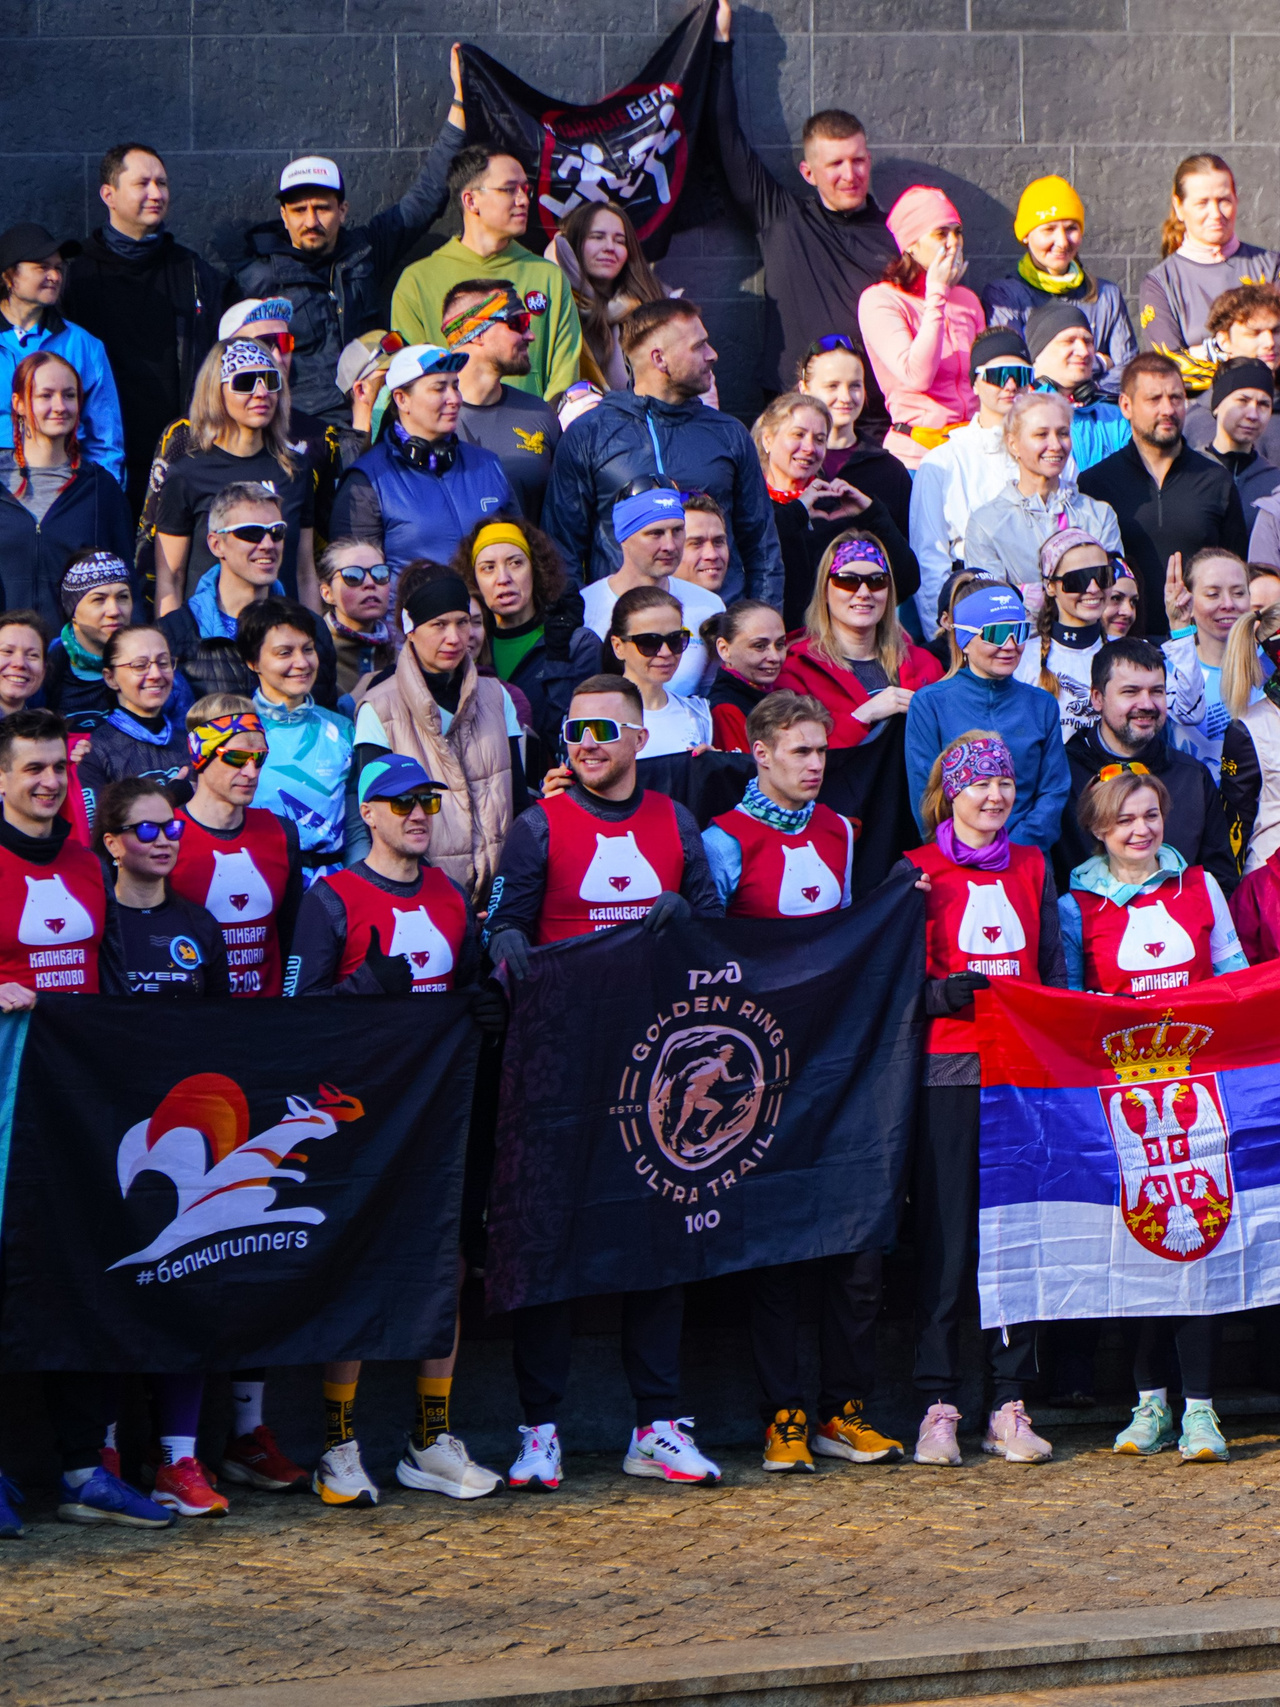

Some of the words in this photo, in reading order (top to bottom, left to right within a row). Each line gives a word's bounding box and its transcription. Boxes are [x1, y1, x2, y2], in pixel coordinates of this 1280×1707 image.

[626, 83, 675, 120] БЕГА
[222, 926, 267, 945] АПИБАРА
[29, 948, 85, 969] КАПИБАРА
[226, 948, 264, 966] УСКОВО
[967, 959, 1020, 977] КАПИБАРА
[36, 969, 85, 989] КУСКОВО
[229, 970, 262, 993] 5:00
[1131, 970, 1189, 993] КАПИБАРА
[632, 996, 731, 1062] GOLDEN
[738, 1000, 785, 1048] RING
[609, 1104, 642, 1115] ESTD
[634, 1154, 699, 1205] ULTRA
[707, 1133, 775, 1197] TRAIL
[685, 1209, 721, 1233] 100
